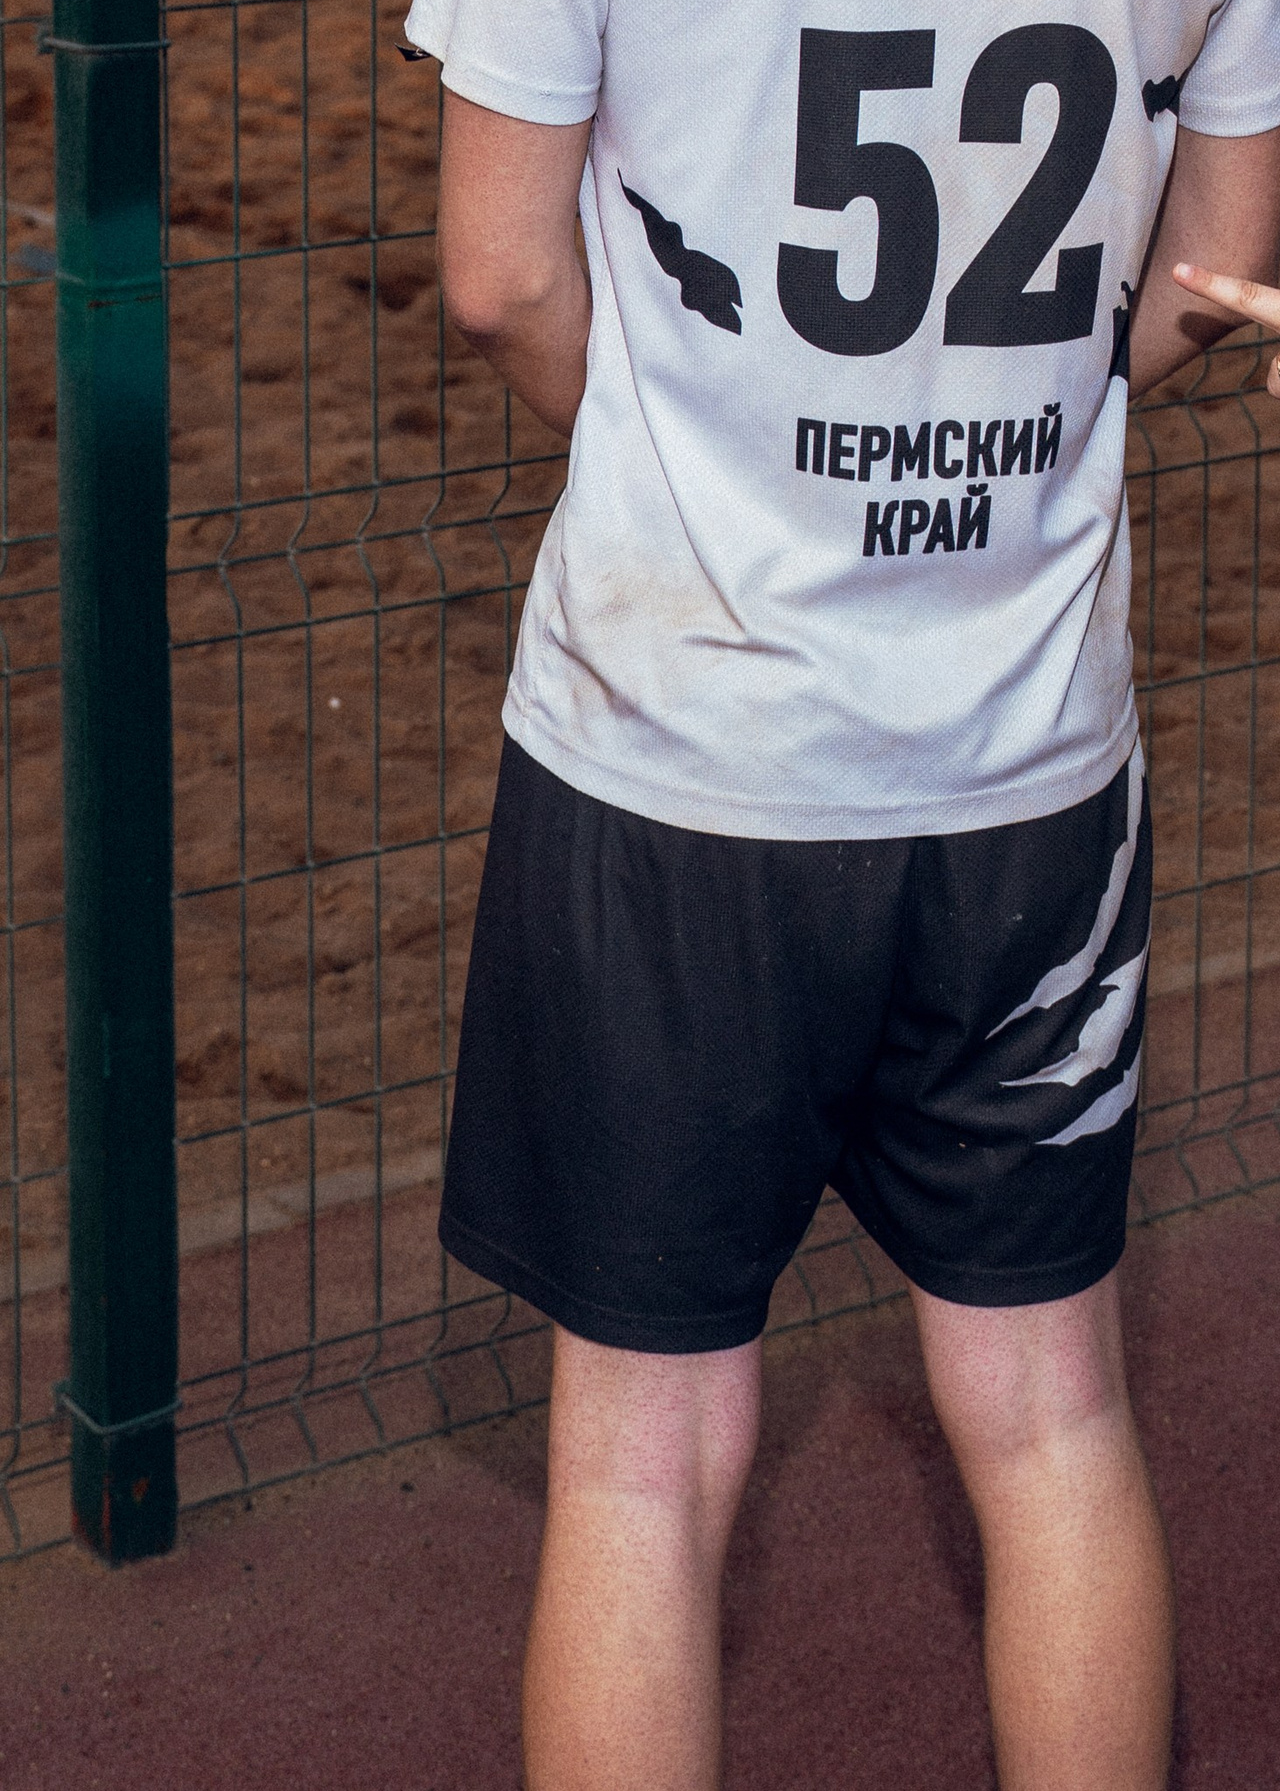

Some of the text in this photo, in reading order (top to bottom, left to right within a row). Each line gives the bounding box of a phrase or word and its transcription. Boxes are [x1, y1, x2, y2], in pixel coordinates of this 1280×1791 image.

[776, 22, 1118, 357] 52
[795, 401, 1063, 483] ПЕРМСКИЙ
[862, 482, 992, 557] КРАЙ
